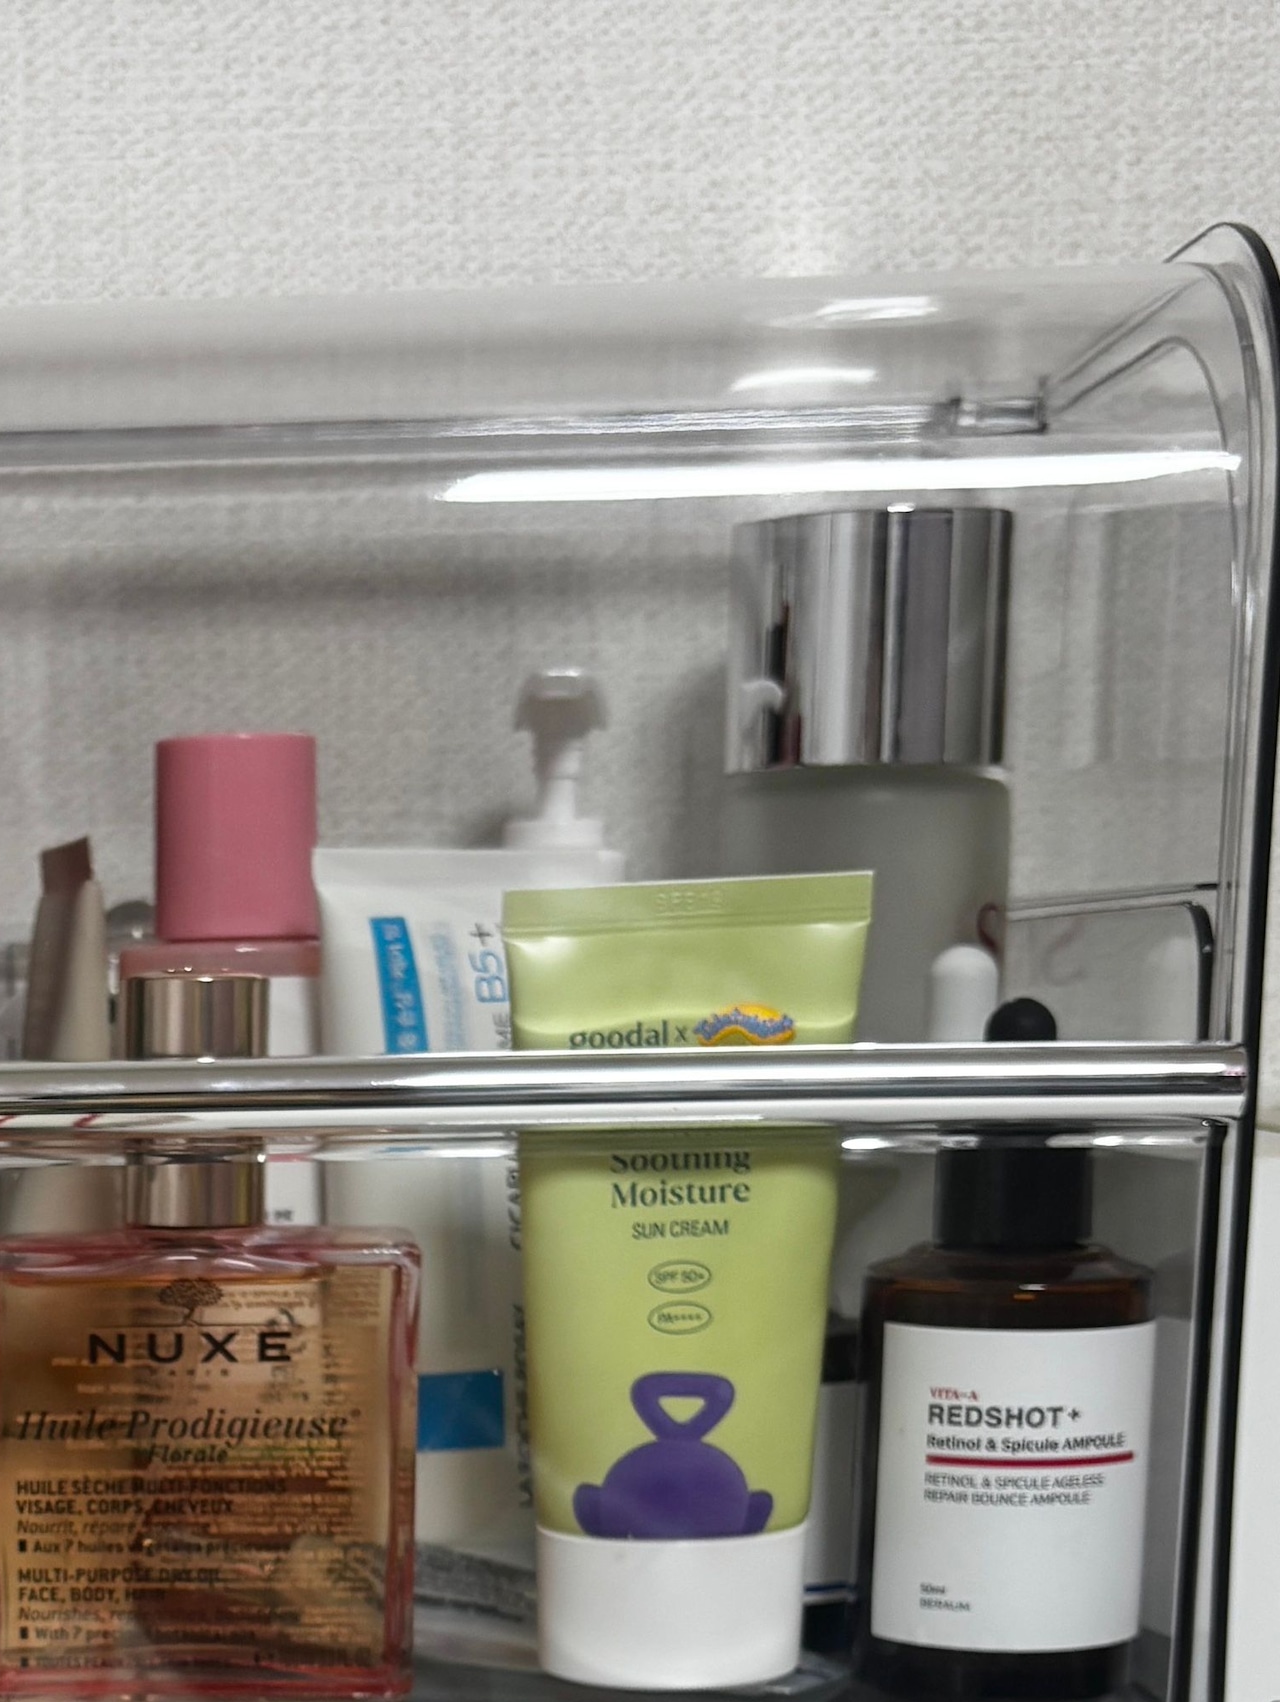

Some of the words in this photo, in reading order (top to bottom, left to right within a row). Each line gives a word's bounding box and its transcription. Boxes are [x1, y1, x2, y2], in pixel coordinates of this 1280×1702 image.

[570, 1020, 668, 1049] goodal
[610, 1151, 752, 1175] Soothing
[611, 1179, 751, 1208] Moisture
[632, 1221, 665, 1240] SUN
[670, 1219, 729, 1237] CREAM
[89, 1332, 293, 1363] NUXE
[19, 1409, 118, 1441] Huile
[926, 1433, 981, 1450] Retinol
[985, 1437, 996, 1451] &
[1001, 1437, 1060, 1453] Spicule
[1062, 1432, 1127, 1450] AMPOULE
[16, 1480, 68, 1495] HUILE
[924, 1472, 977, 1487] RETINOL
[994, 1474, 1051, 1489] SPICULE
[1052, 1472, 1106, 1488] AGELESS
[923, 1489, 969, 1504] REPAIR
[972, 1491, 1028, 1506] BOUNCE
[1030, 1490, 1092, 1506] AMPOULE
[16, 1500, 83, 1515] VISAGE,
[33, 1540, 61, 1552] Aux
[18, 1568, 152, 1583] MULTI-PURPOSE
[19, 1587, 66, 1604] FACE,
[71, 1587, 120, 1604] BODY,
